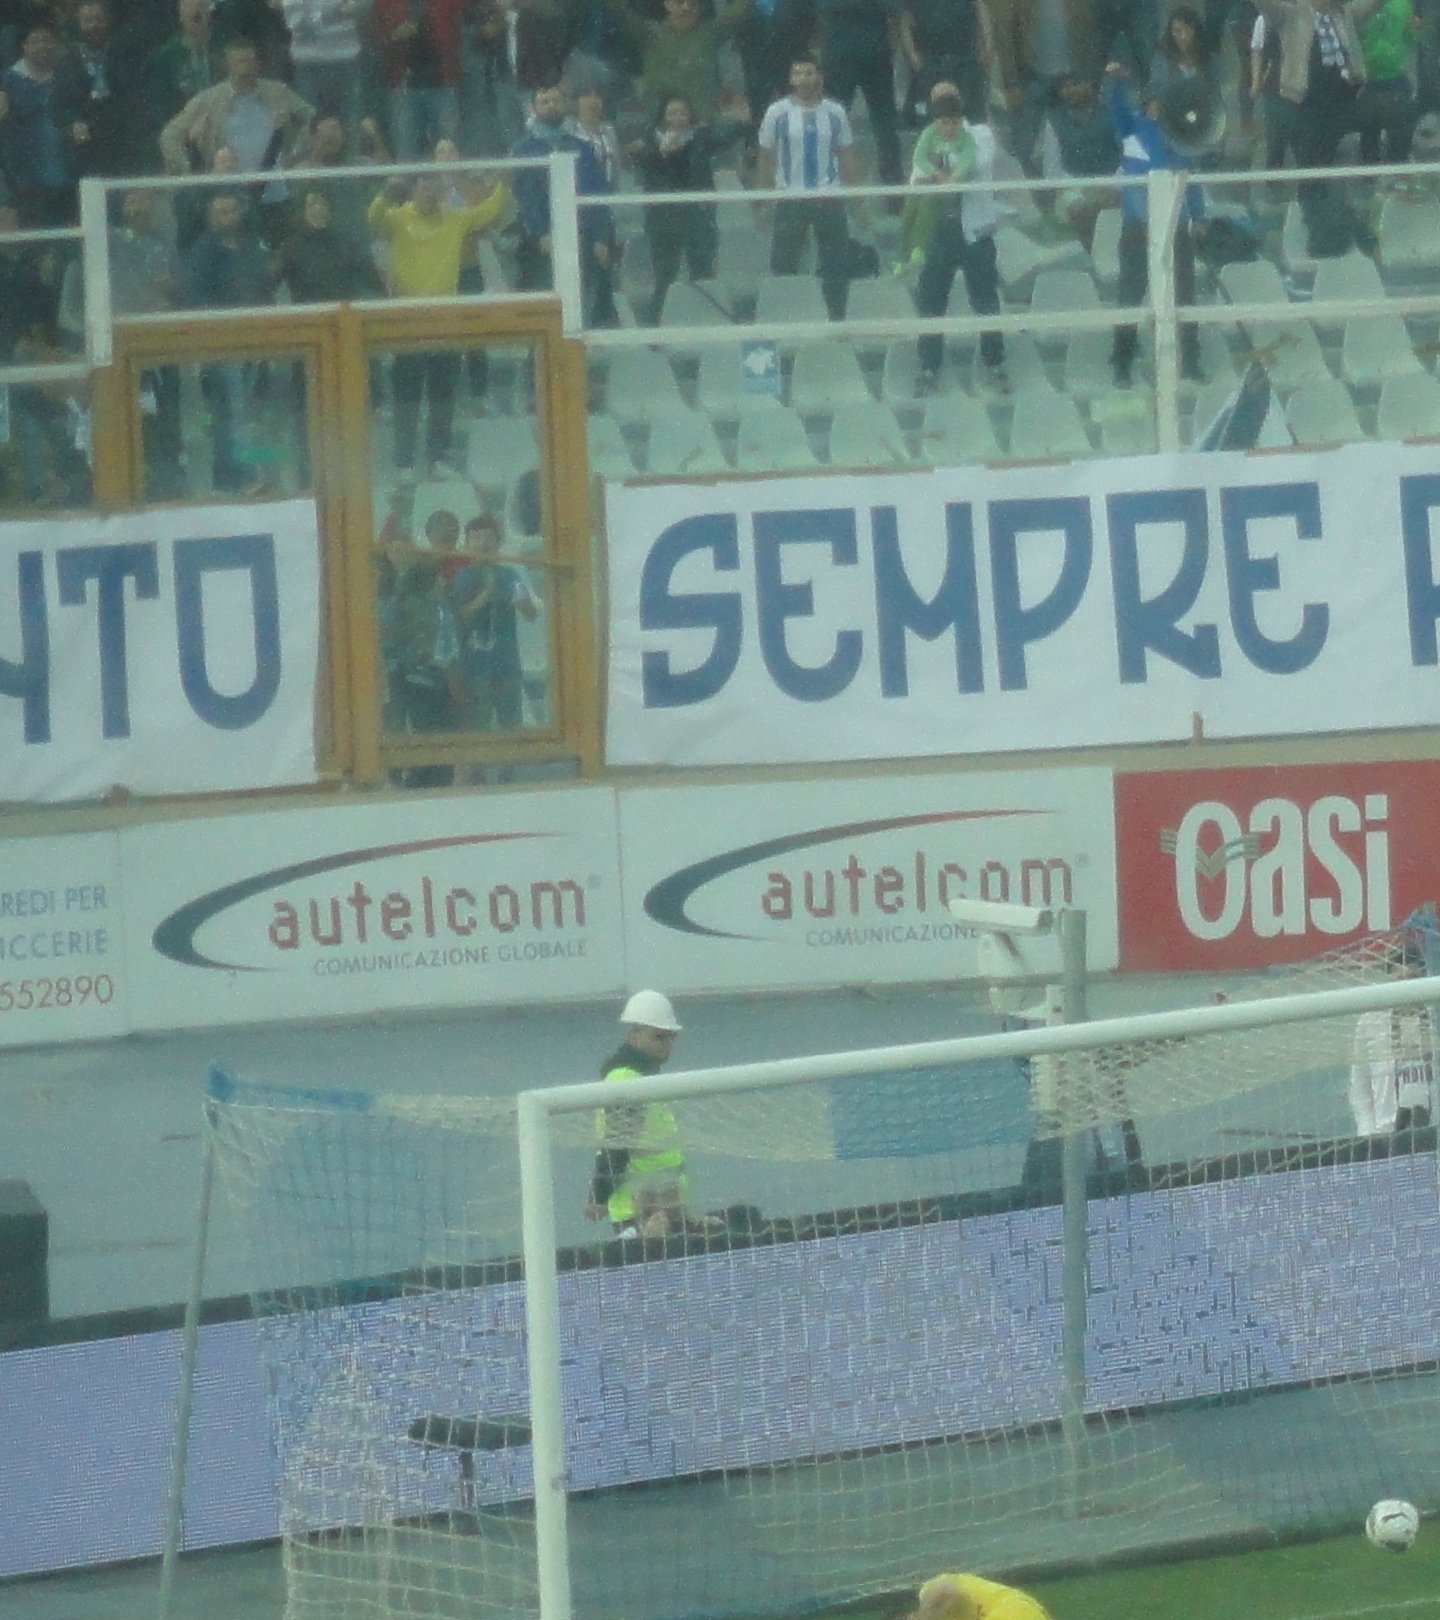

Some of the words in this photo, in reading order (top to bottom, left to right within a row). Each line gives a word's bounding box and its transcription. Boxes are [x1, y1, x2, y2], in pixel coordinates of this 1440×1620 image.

[639, 482, 1330, 709] SEMPRE
[64, 884, 108, 911] PER
[268, 876, 586, 950] autelcom
[762, 850, 1073, 920] autelcom
[313, 945, 490, 976] COMUNICAZIONE
[497, 938, 587, 963] GLOBALE
